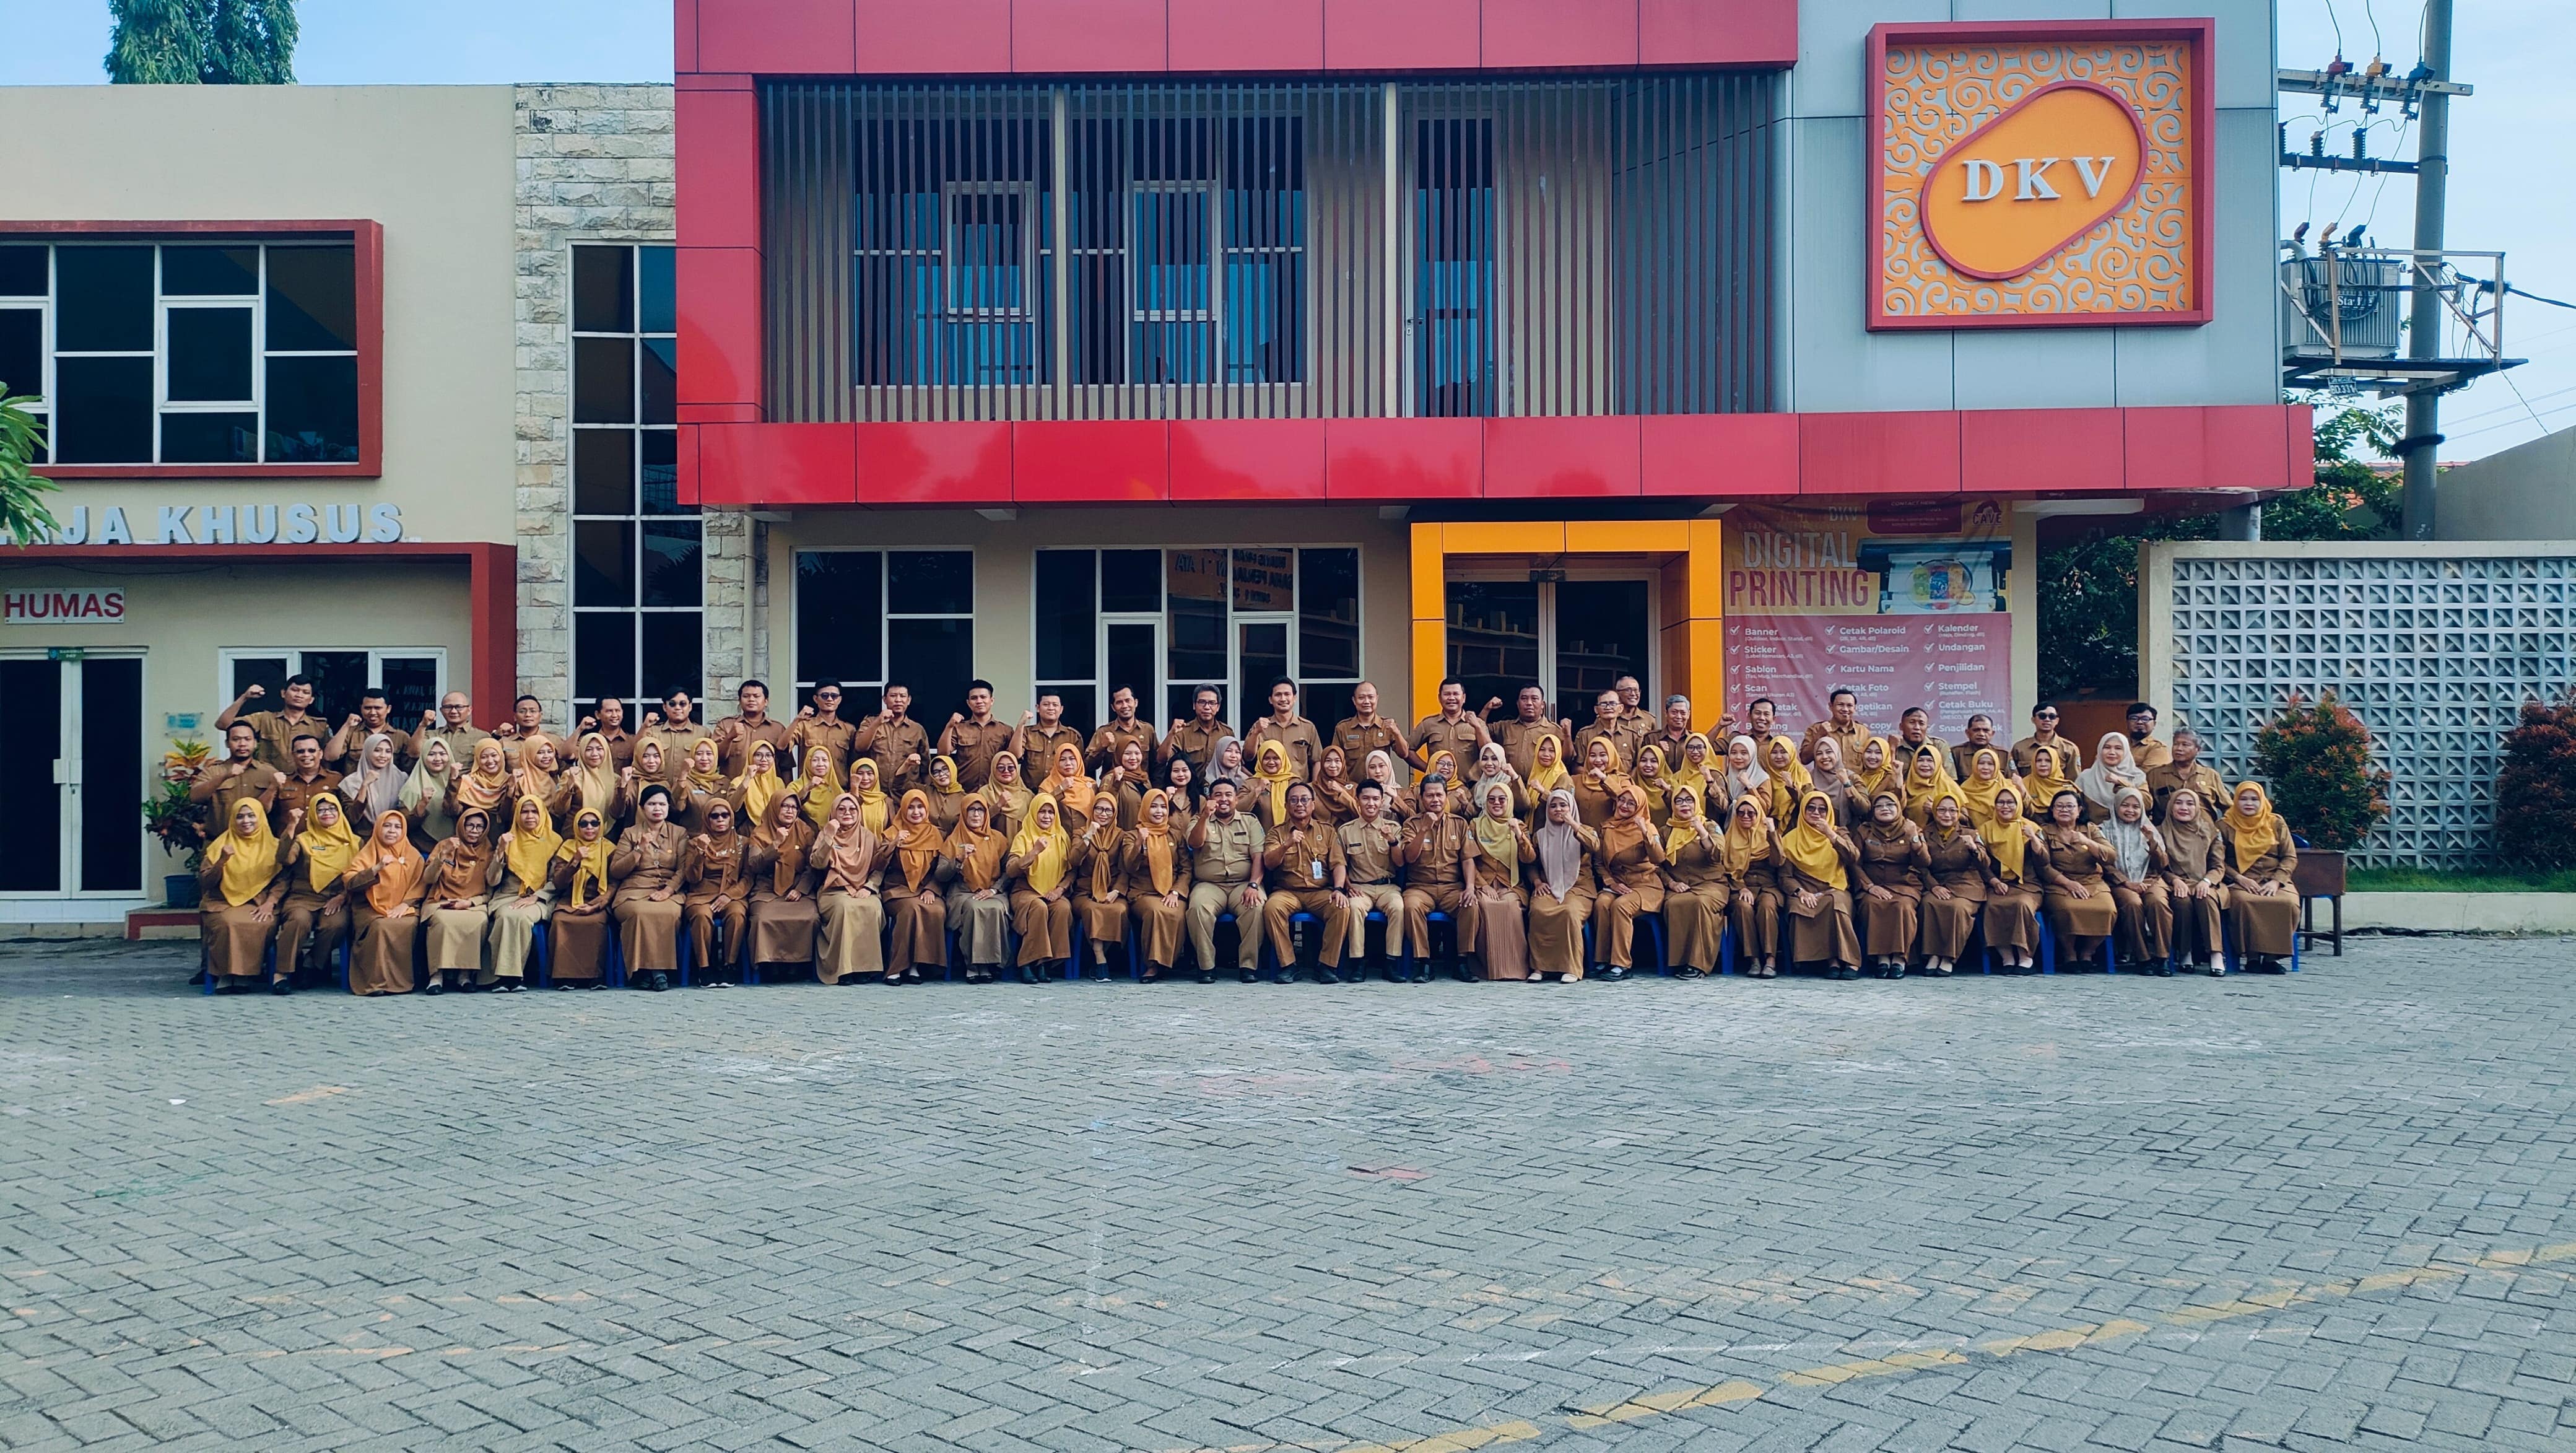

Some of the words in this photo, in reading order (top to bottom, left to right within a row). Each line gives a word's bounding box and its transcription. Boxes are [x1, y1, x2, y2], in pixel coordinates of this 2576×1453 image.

[158, 503, 404, 544] KHUSUS
[1973, 513, 2002, 525] CAVE
[1743, 531, 1858, 568] DIGITAL
[1729, 570, 1869, 607] PRINTING
[4, 592, 124, 618] HUMAS
[1938, 624, 1978, 632] Kalender
[1744, 645, 1777, 653] Sticker
[1840, 644, 1910, 653] Gambar/Desain
[1939, 644, 1985, 652] Undangan
[1745, 665, 1777, 673] Sablon
[1938, 663, 1985, 672] Penjilidan
[1938, 682, 1977, 691] Stempel
[1938, 700, 1966, 709] Cetak
[1870, 722, 1892, 730] copy
[1938, 724, 1965, 732] Snack
